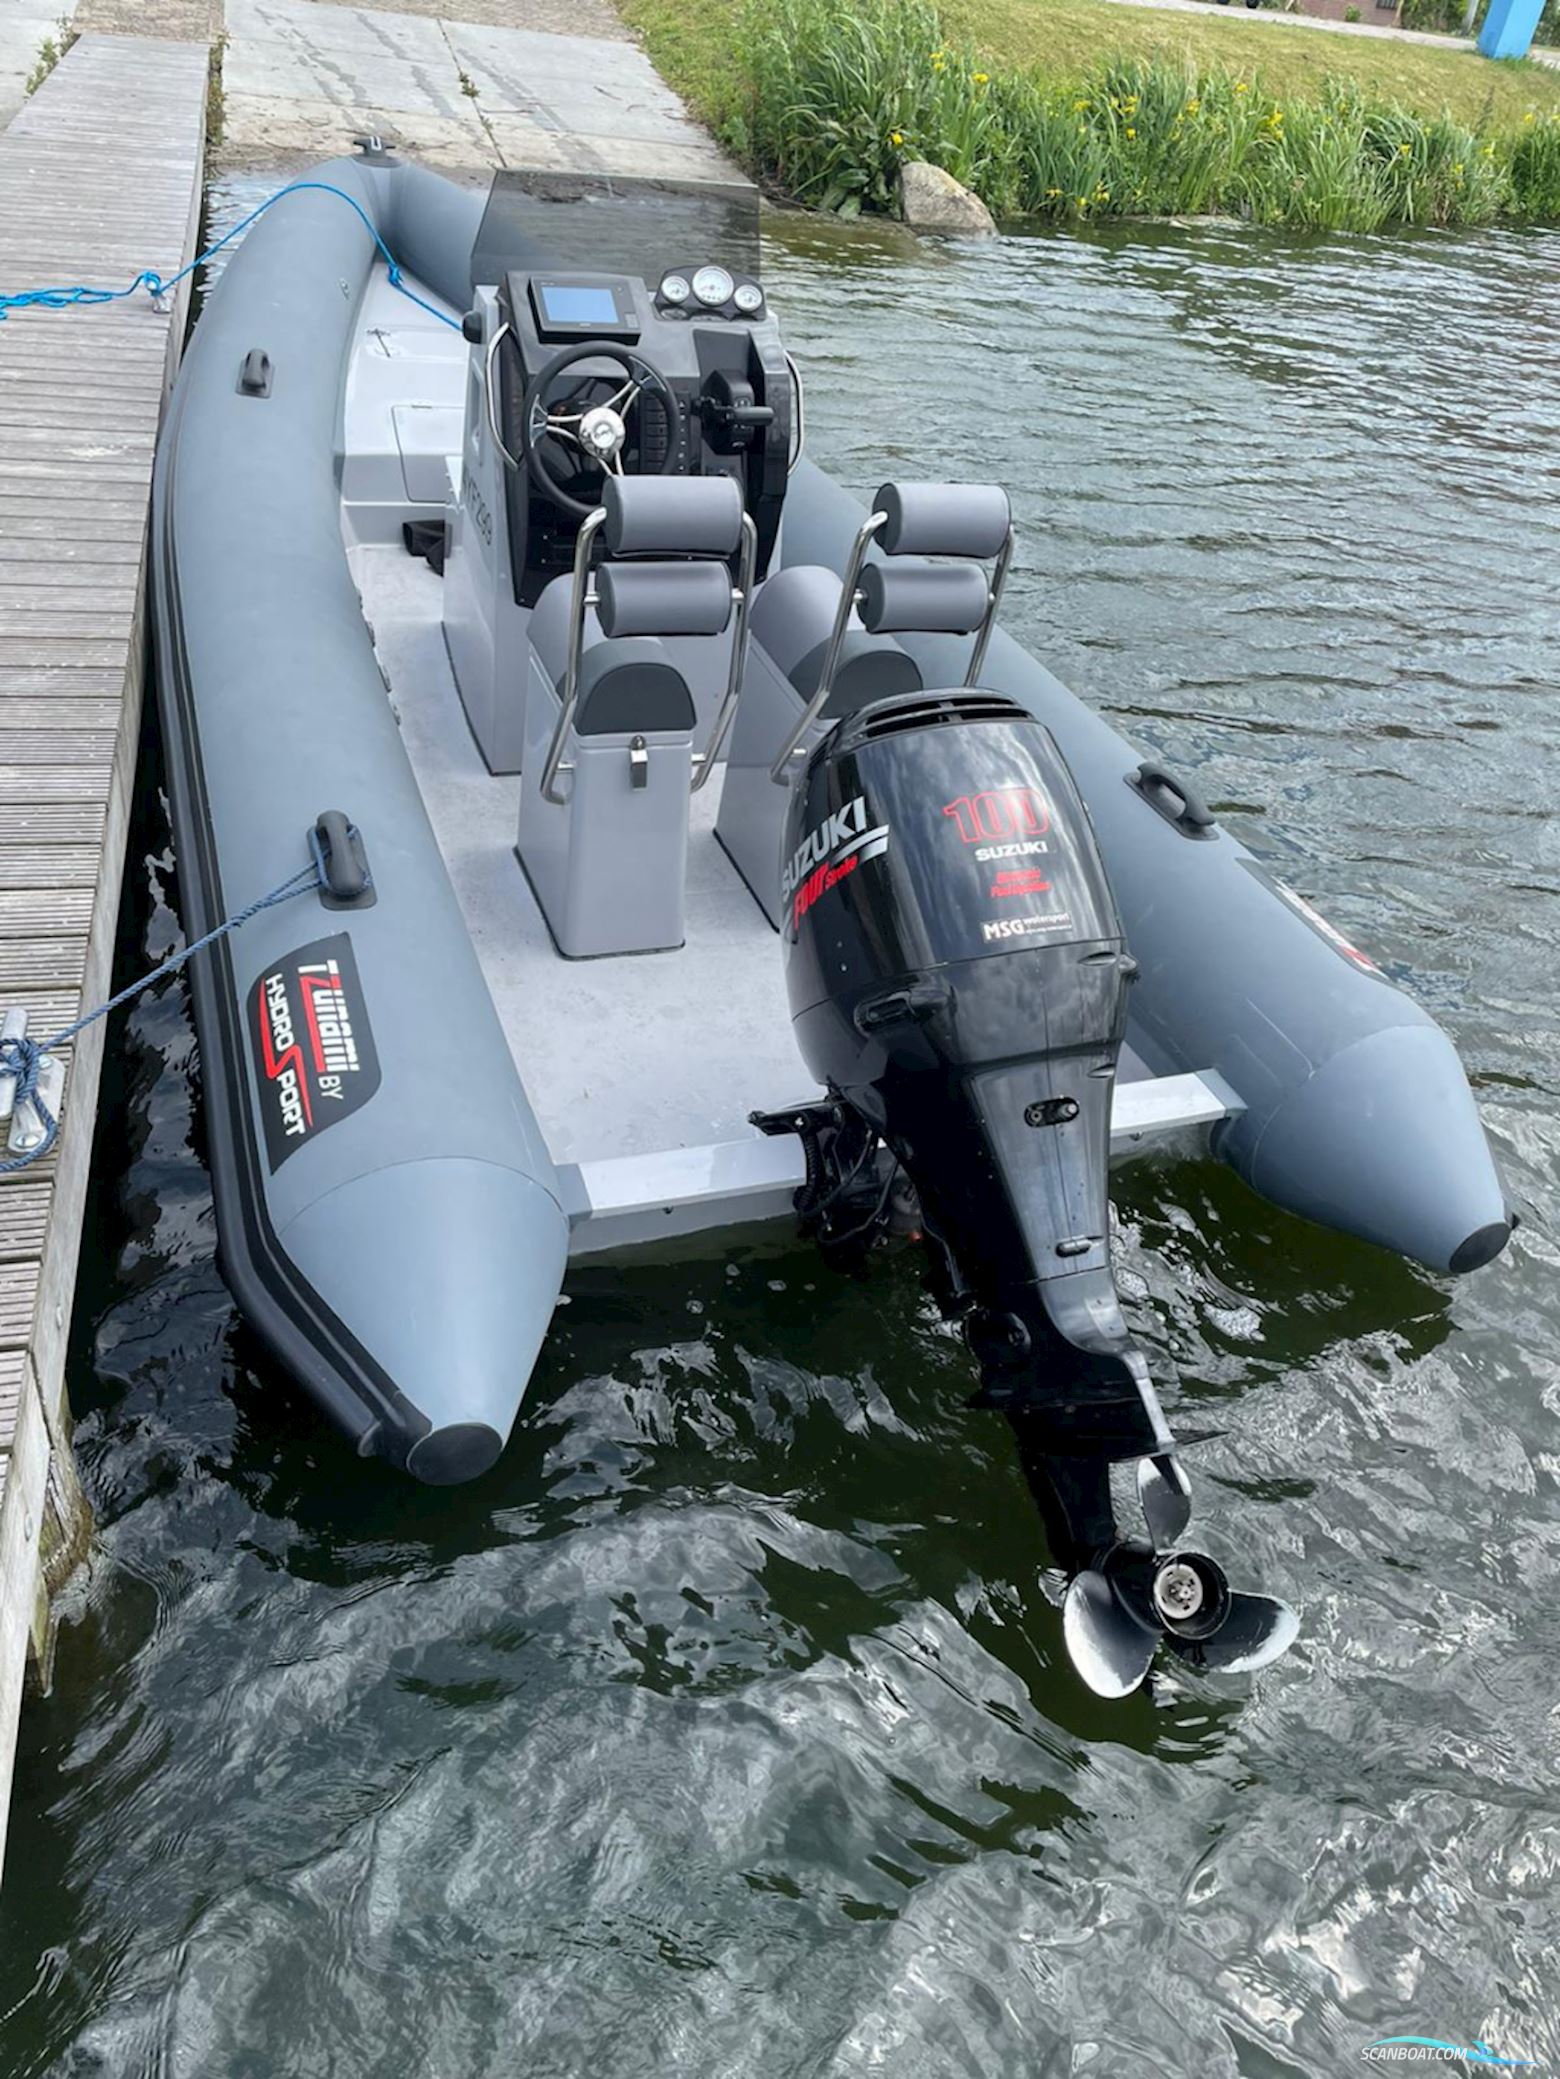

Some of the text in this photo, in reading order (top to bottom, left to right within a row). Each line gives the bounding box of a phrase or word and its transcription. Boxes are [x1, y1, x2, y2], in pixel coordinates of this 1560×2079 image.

[943, 787, 1050, 843] 100
[782, 795, 867, 902] SUZUKI
[975, 841, 1049, 862] SUZUKI
[983, 918, 1025, 940] MSG
[318, 1075, 344, 1100] BY
